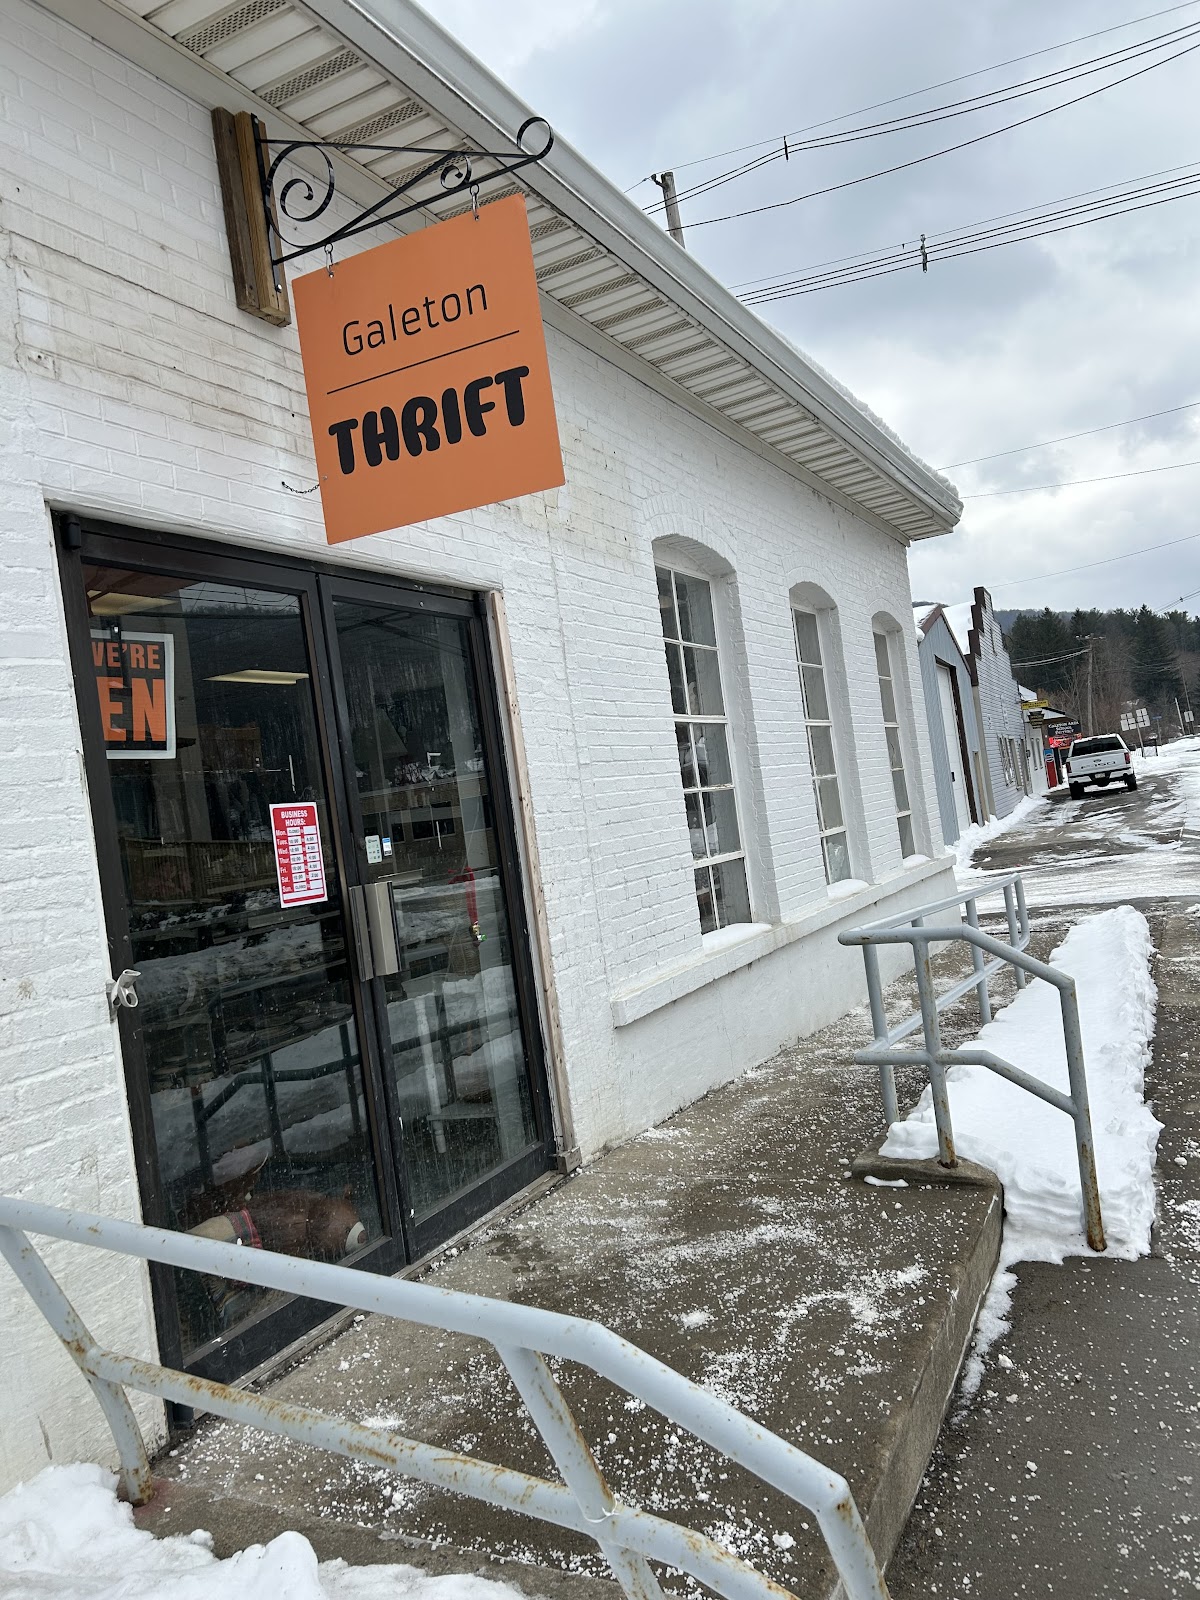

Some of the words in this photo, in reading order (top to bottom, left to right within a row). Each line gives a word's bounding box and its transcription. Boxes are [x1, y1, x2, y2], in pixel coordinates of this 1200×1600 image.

[342, 283, 488, 356] Galeton
[328, 365, 530, 475] THRIFT
[281, 810, 308, 818] BUSINESS
